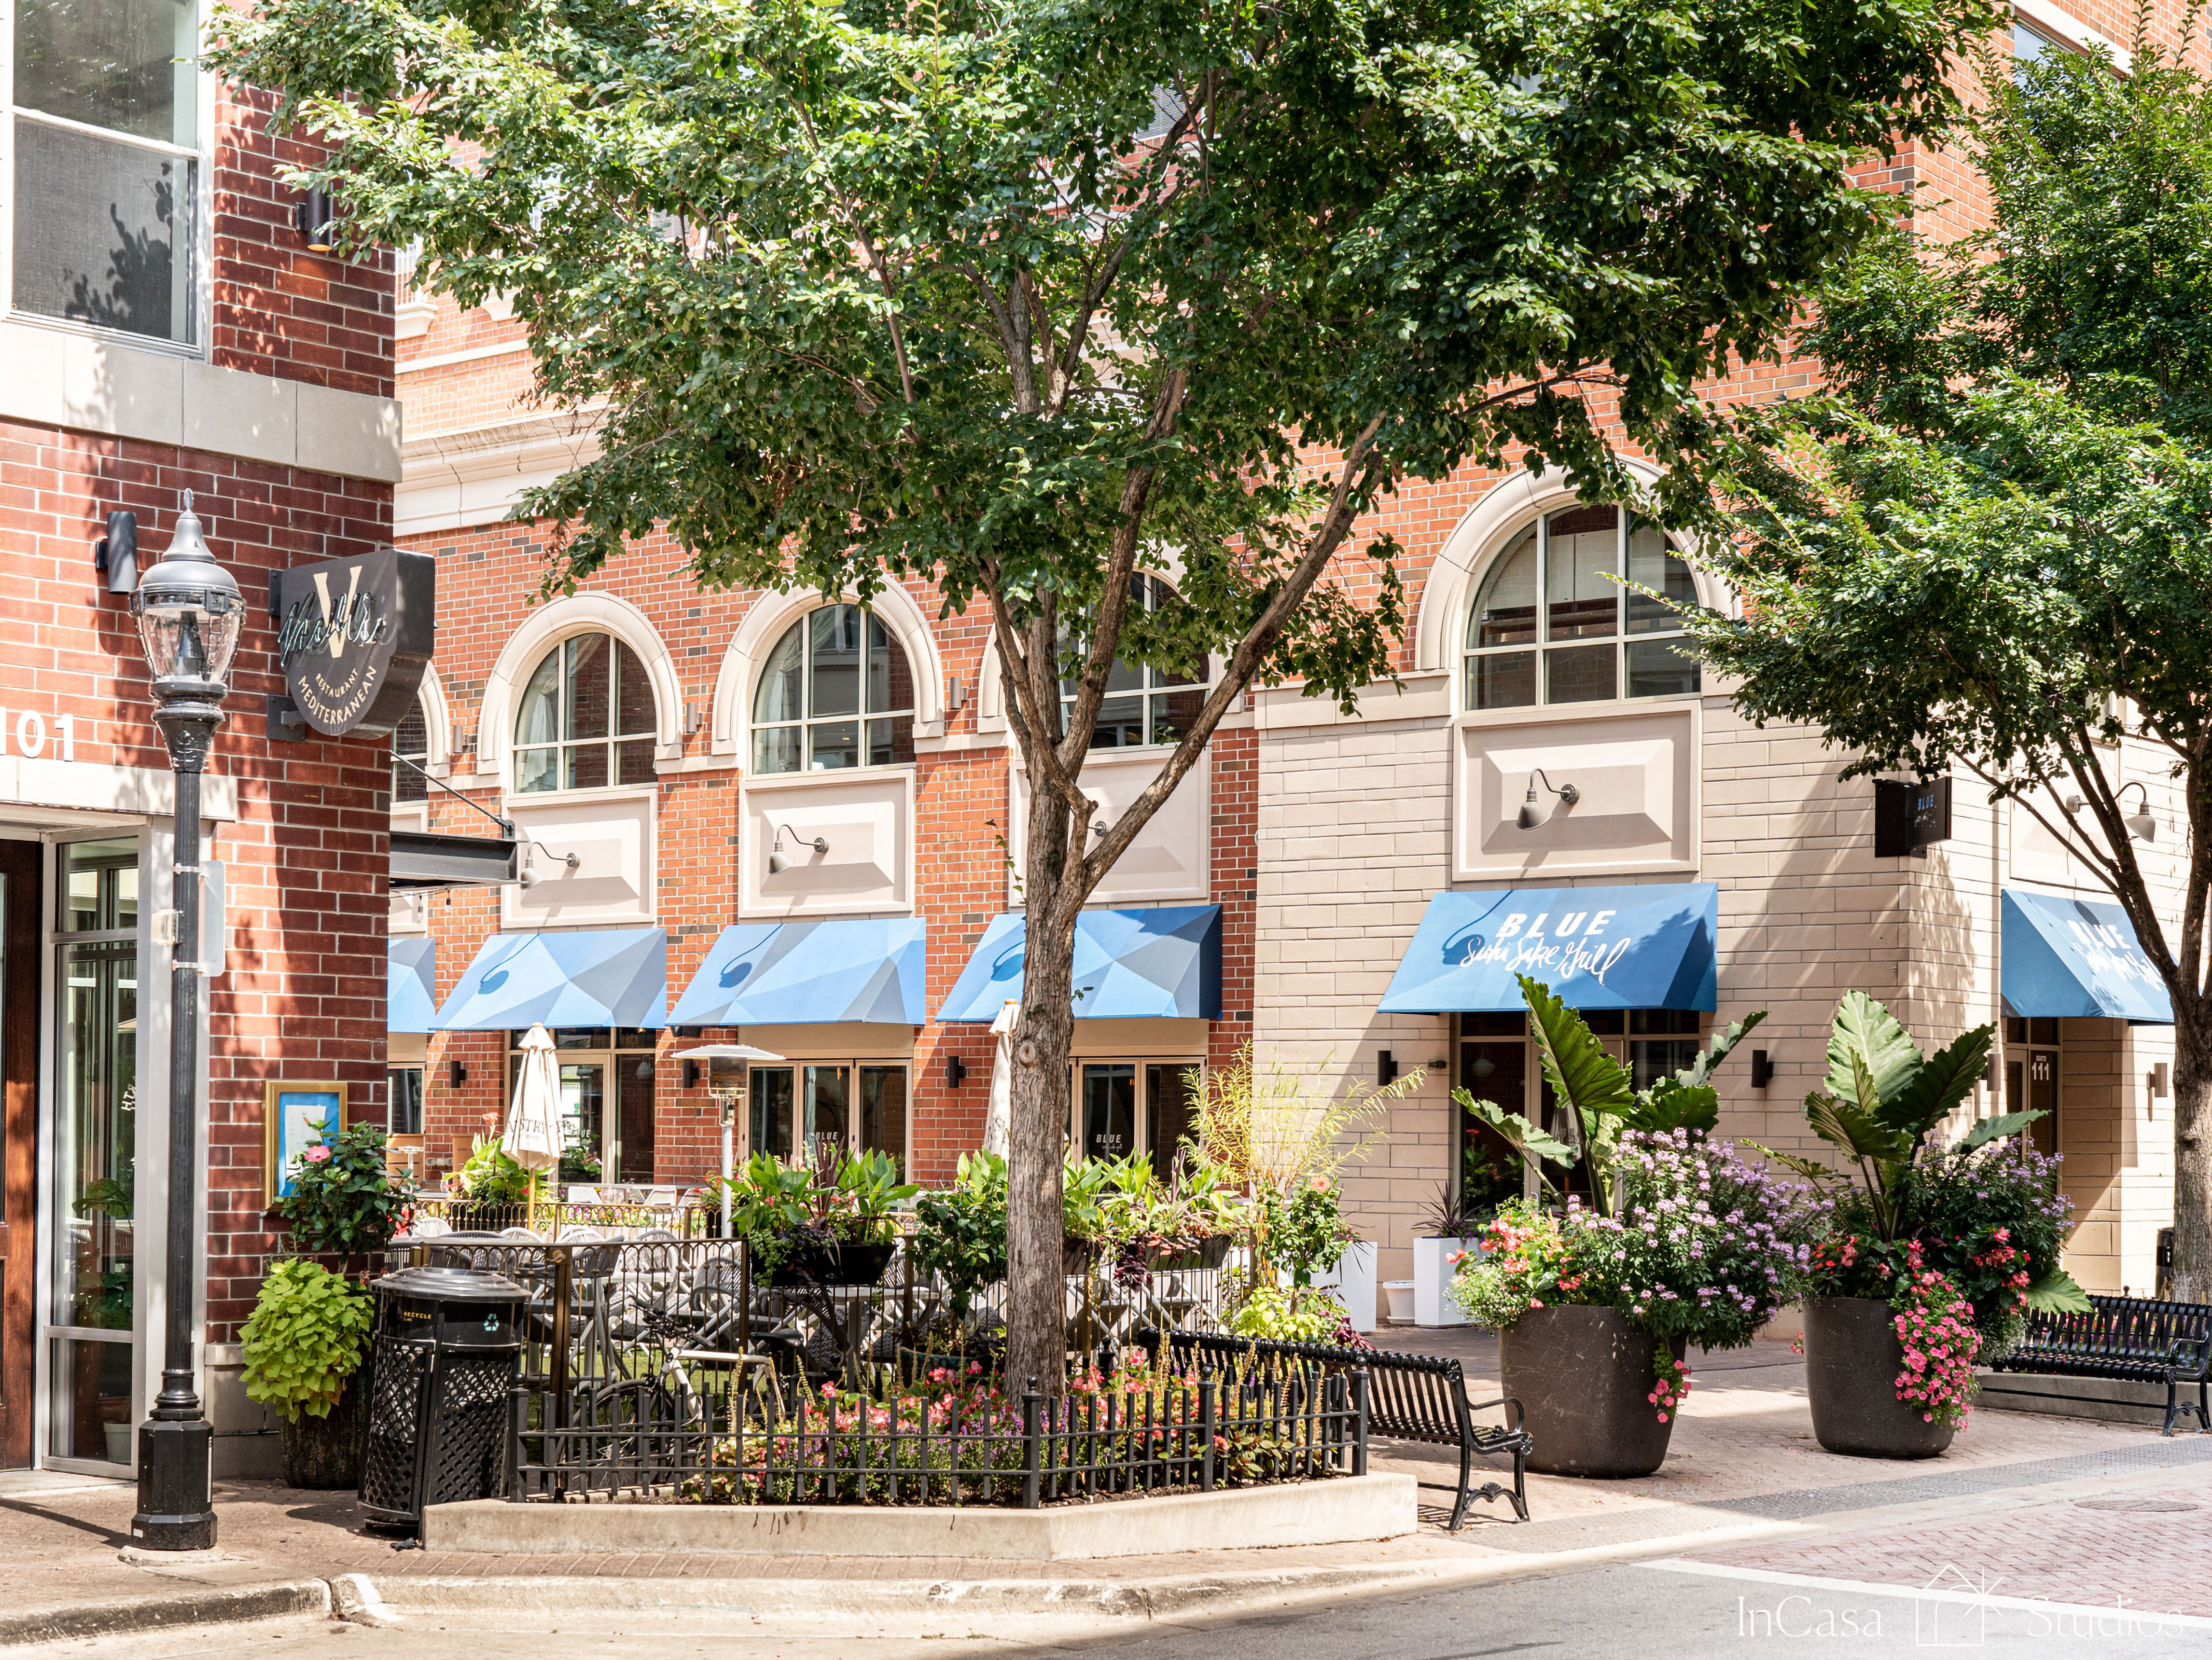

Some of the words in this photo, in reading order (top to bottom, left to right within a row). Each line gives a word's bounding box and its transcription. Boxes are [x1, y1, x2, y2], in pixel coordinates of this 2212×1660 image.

[313, 565, 362, 658] V
[298, 665, 377, 724] MEDITERRANEAN
[316, 668, 358, 698] RESTAURANT
[1495, 910, 1617, 938] BLUE
[2067, 920, 2132, 949] BLUE
[1460, 936, 1511, 968] Sushi
[1504, 936, 1560, 972] Sake
[1553, 937, 1631, 986] Grill
[2031, 1062, 2049, 1080] 111
[815, 1132, 838, 1140] BLUE
[1096, 1134, 1122, 1143] BLUE
